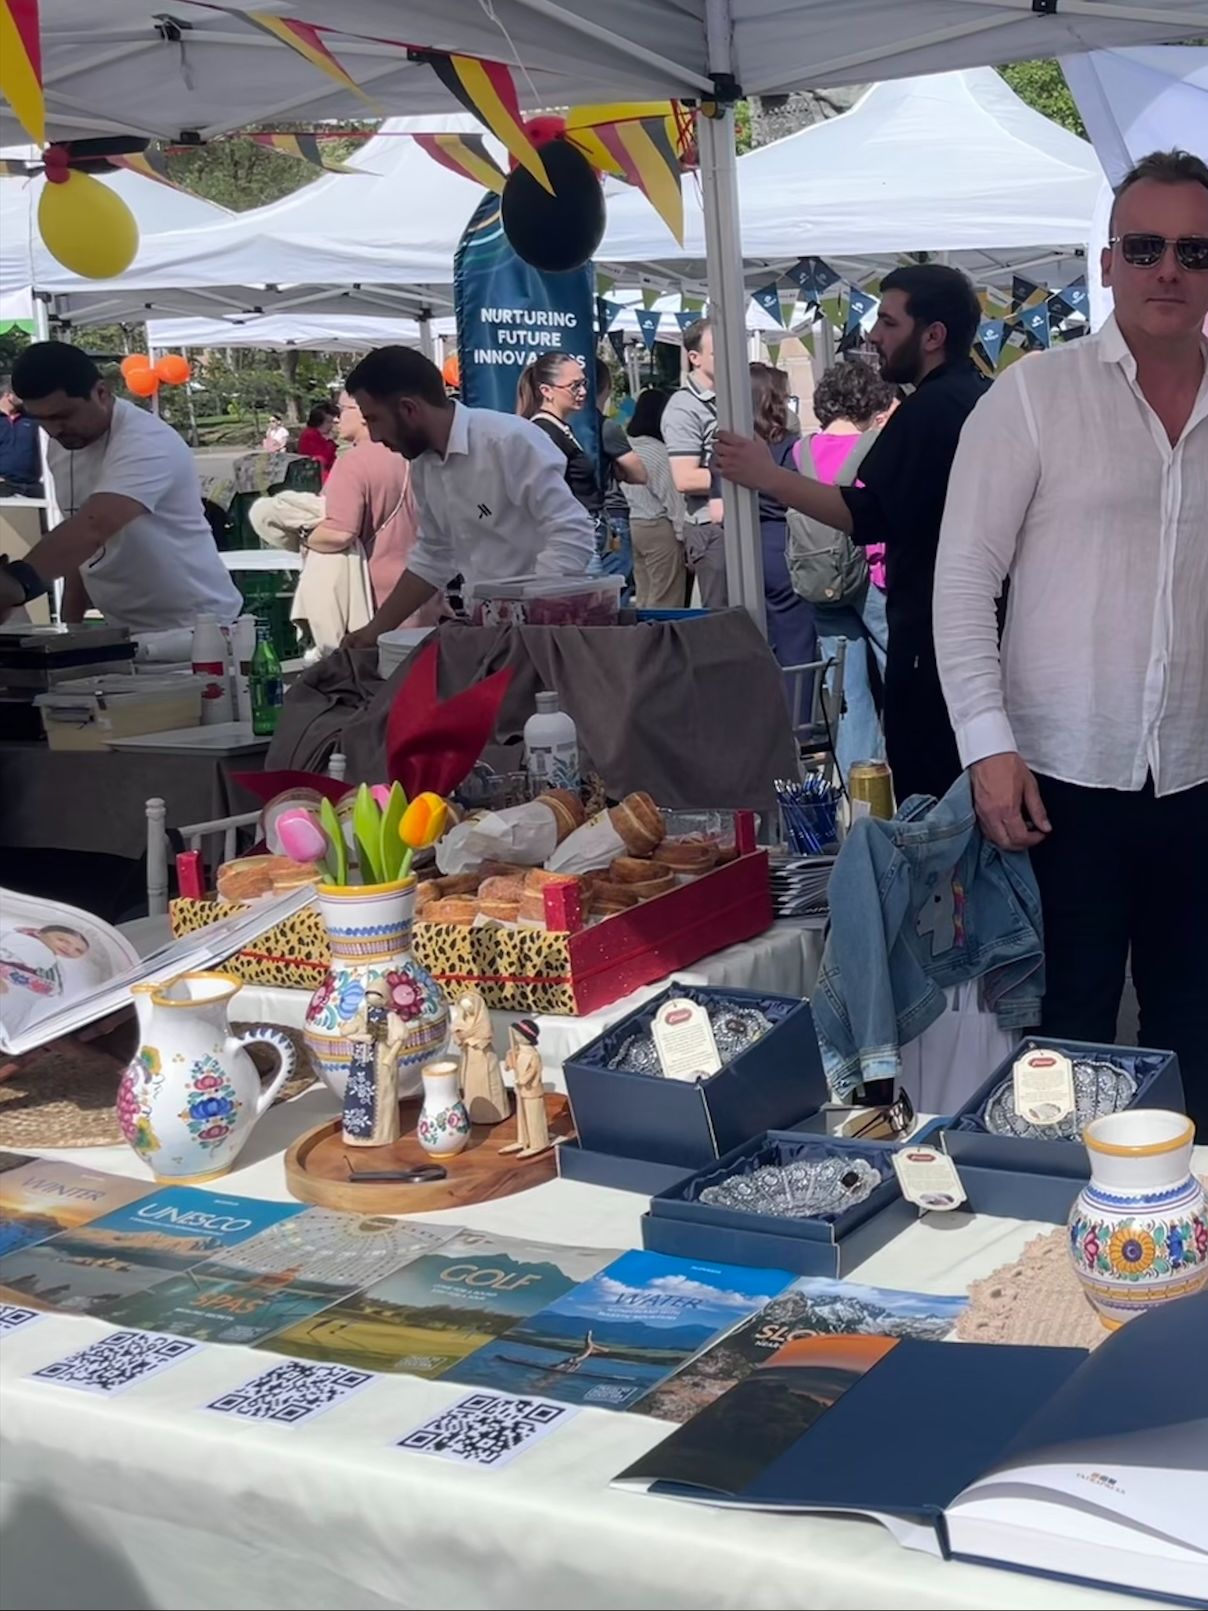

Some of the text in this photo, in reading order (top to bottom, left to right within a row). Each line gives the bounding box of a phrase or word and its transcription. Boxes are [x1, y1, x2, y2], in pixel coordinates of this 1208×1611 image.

[480, 307, 577, 327] NURTURING
[497, 329, 562, 347] FUTURE
[473, 349, 586, 369] INNOVAS
[22, 1176, 106, 1201] WINTER
[137, 1203, 252, 1232] UNESCO
[440, 1264, 542, 1290] GOLF
[615, 1292, 703, 1309] WATER
